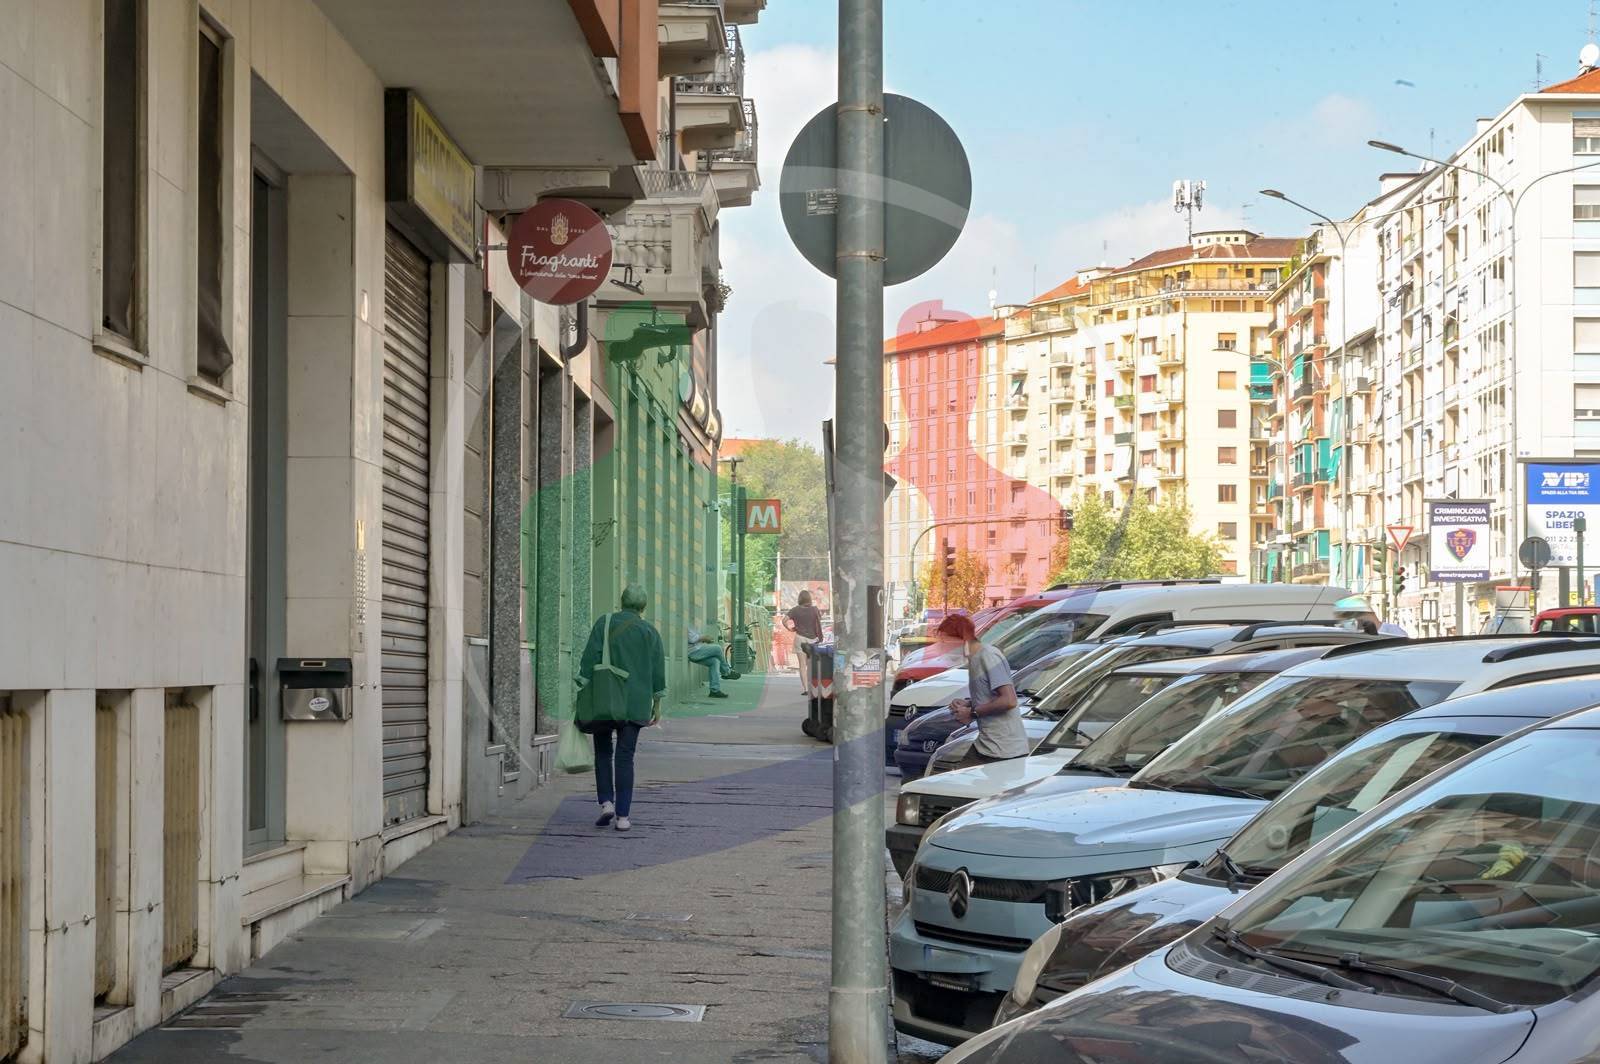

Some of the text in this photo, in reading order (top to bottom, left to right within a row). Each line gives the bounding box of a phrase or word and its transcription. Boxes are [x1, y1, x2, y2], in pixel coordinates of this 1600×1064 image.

[521, 245, 599, 272] Fragranti
[1434, 507, 1486, 515] CRIMINOLOGIA
[1545, 511, 1585, 519] SPAZIO
[748, 505, 778, 528] M
[1546, 521, 1575, 529] LIBER
